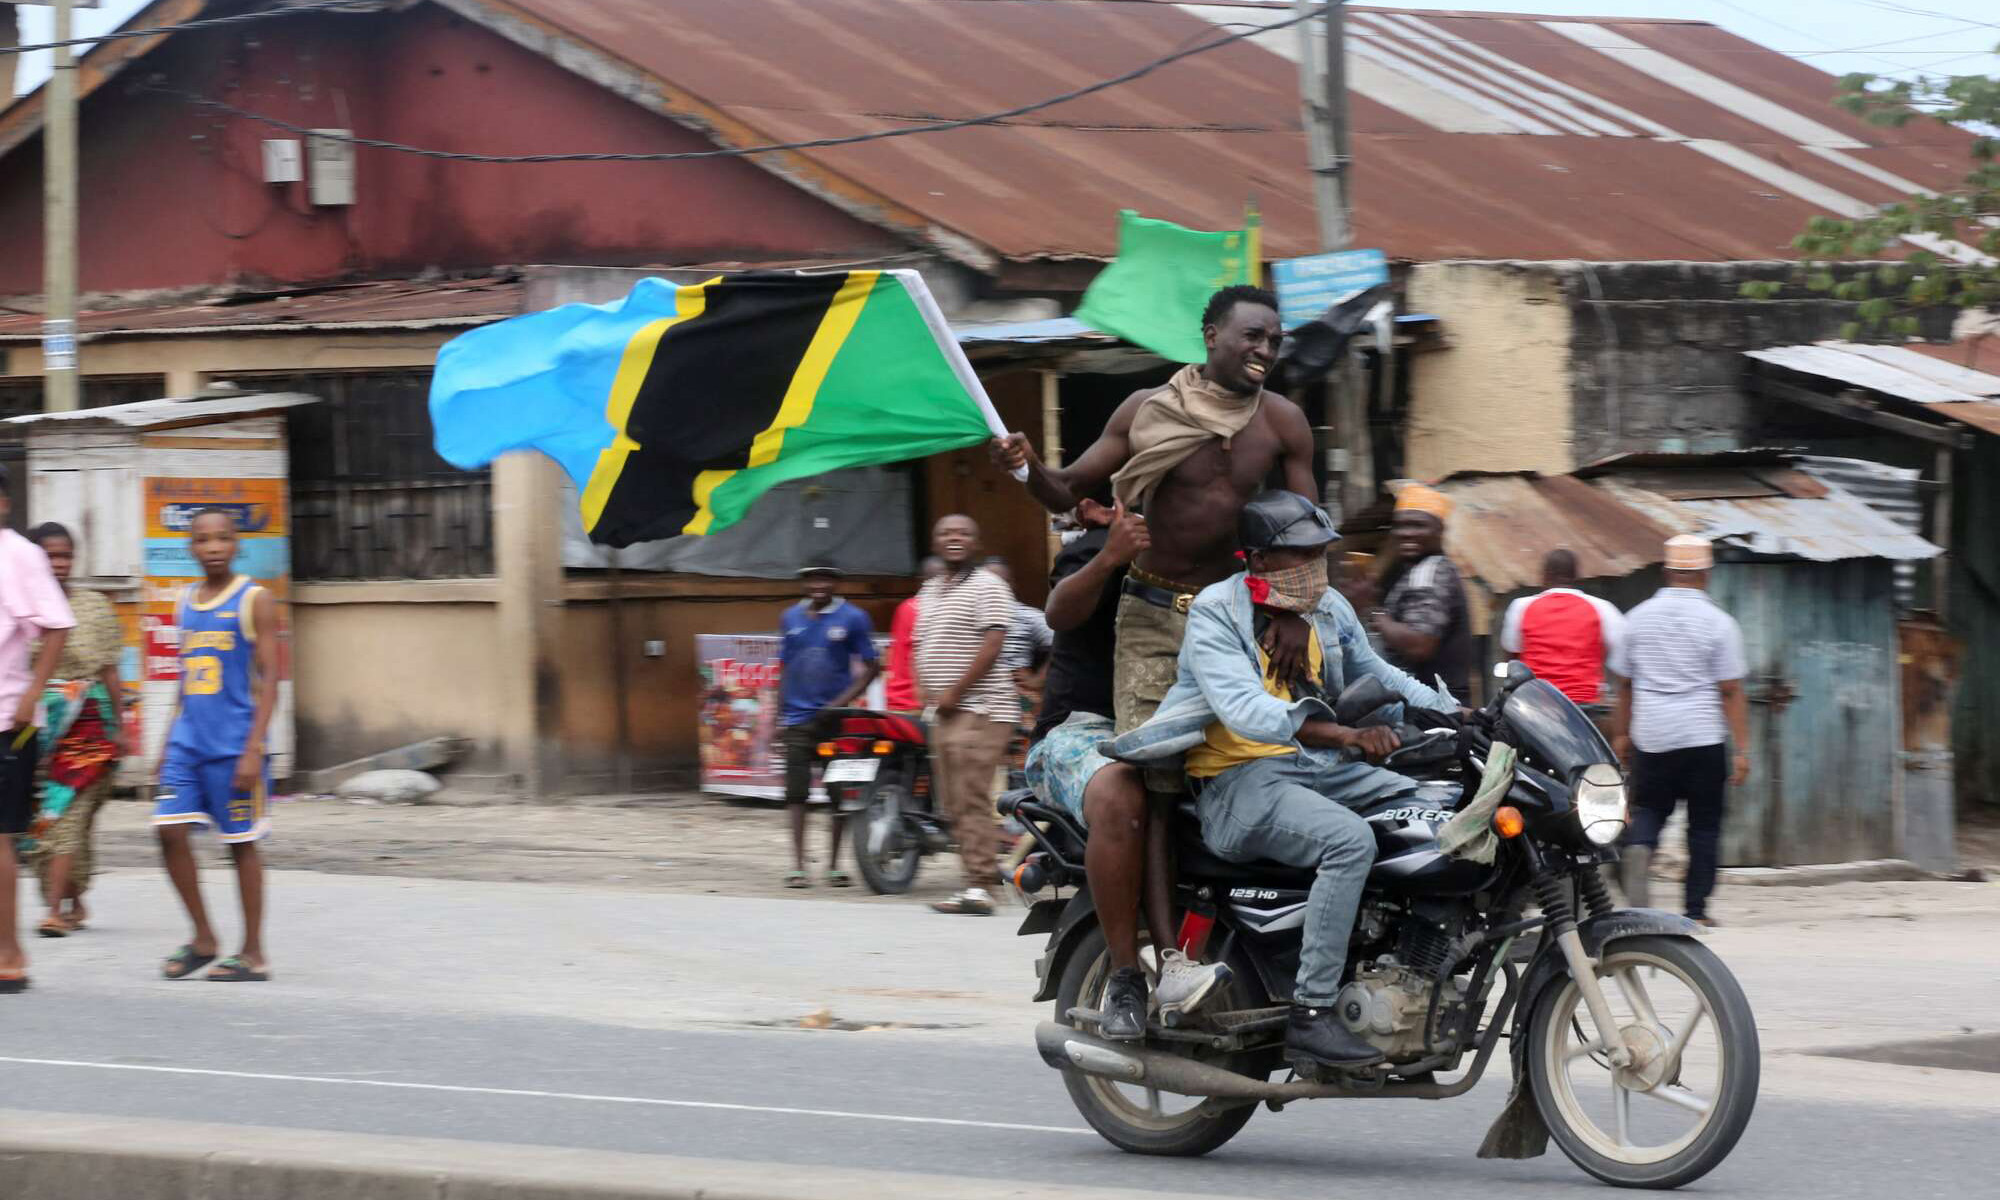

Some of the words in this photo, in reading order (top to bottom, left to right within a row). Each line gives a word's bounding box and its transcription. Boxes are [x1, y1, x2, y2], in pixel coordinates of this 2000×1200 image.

[1382, 807, 1454, 823] BOXER
[1229, 888, 1257, 898] 125
[1257, 890, 1279, 900] HD
